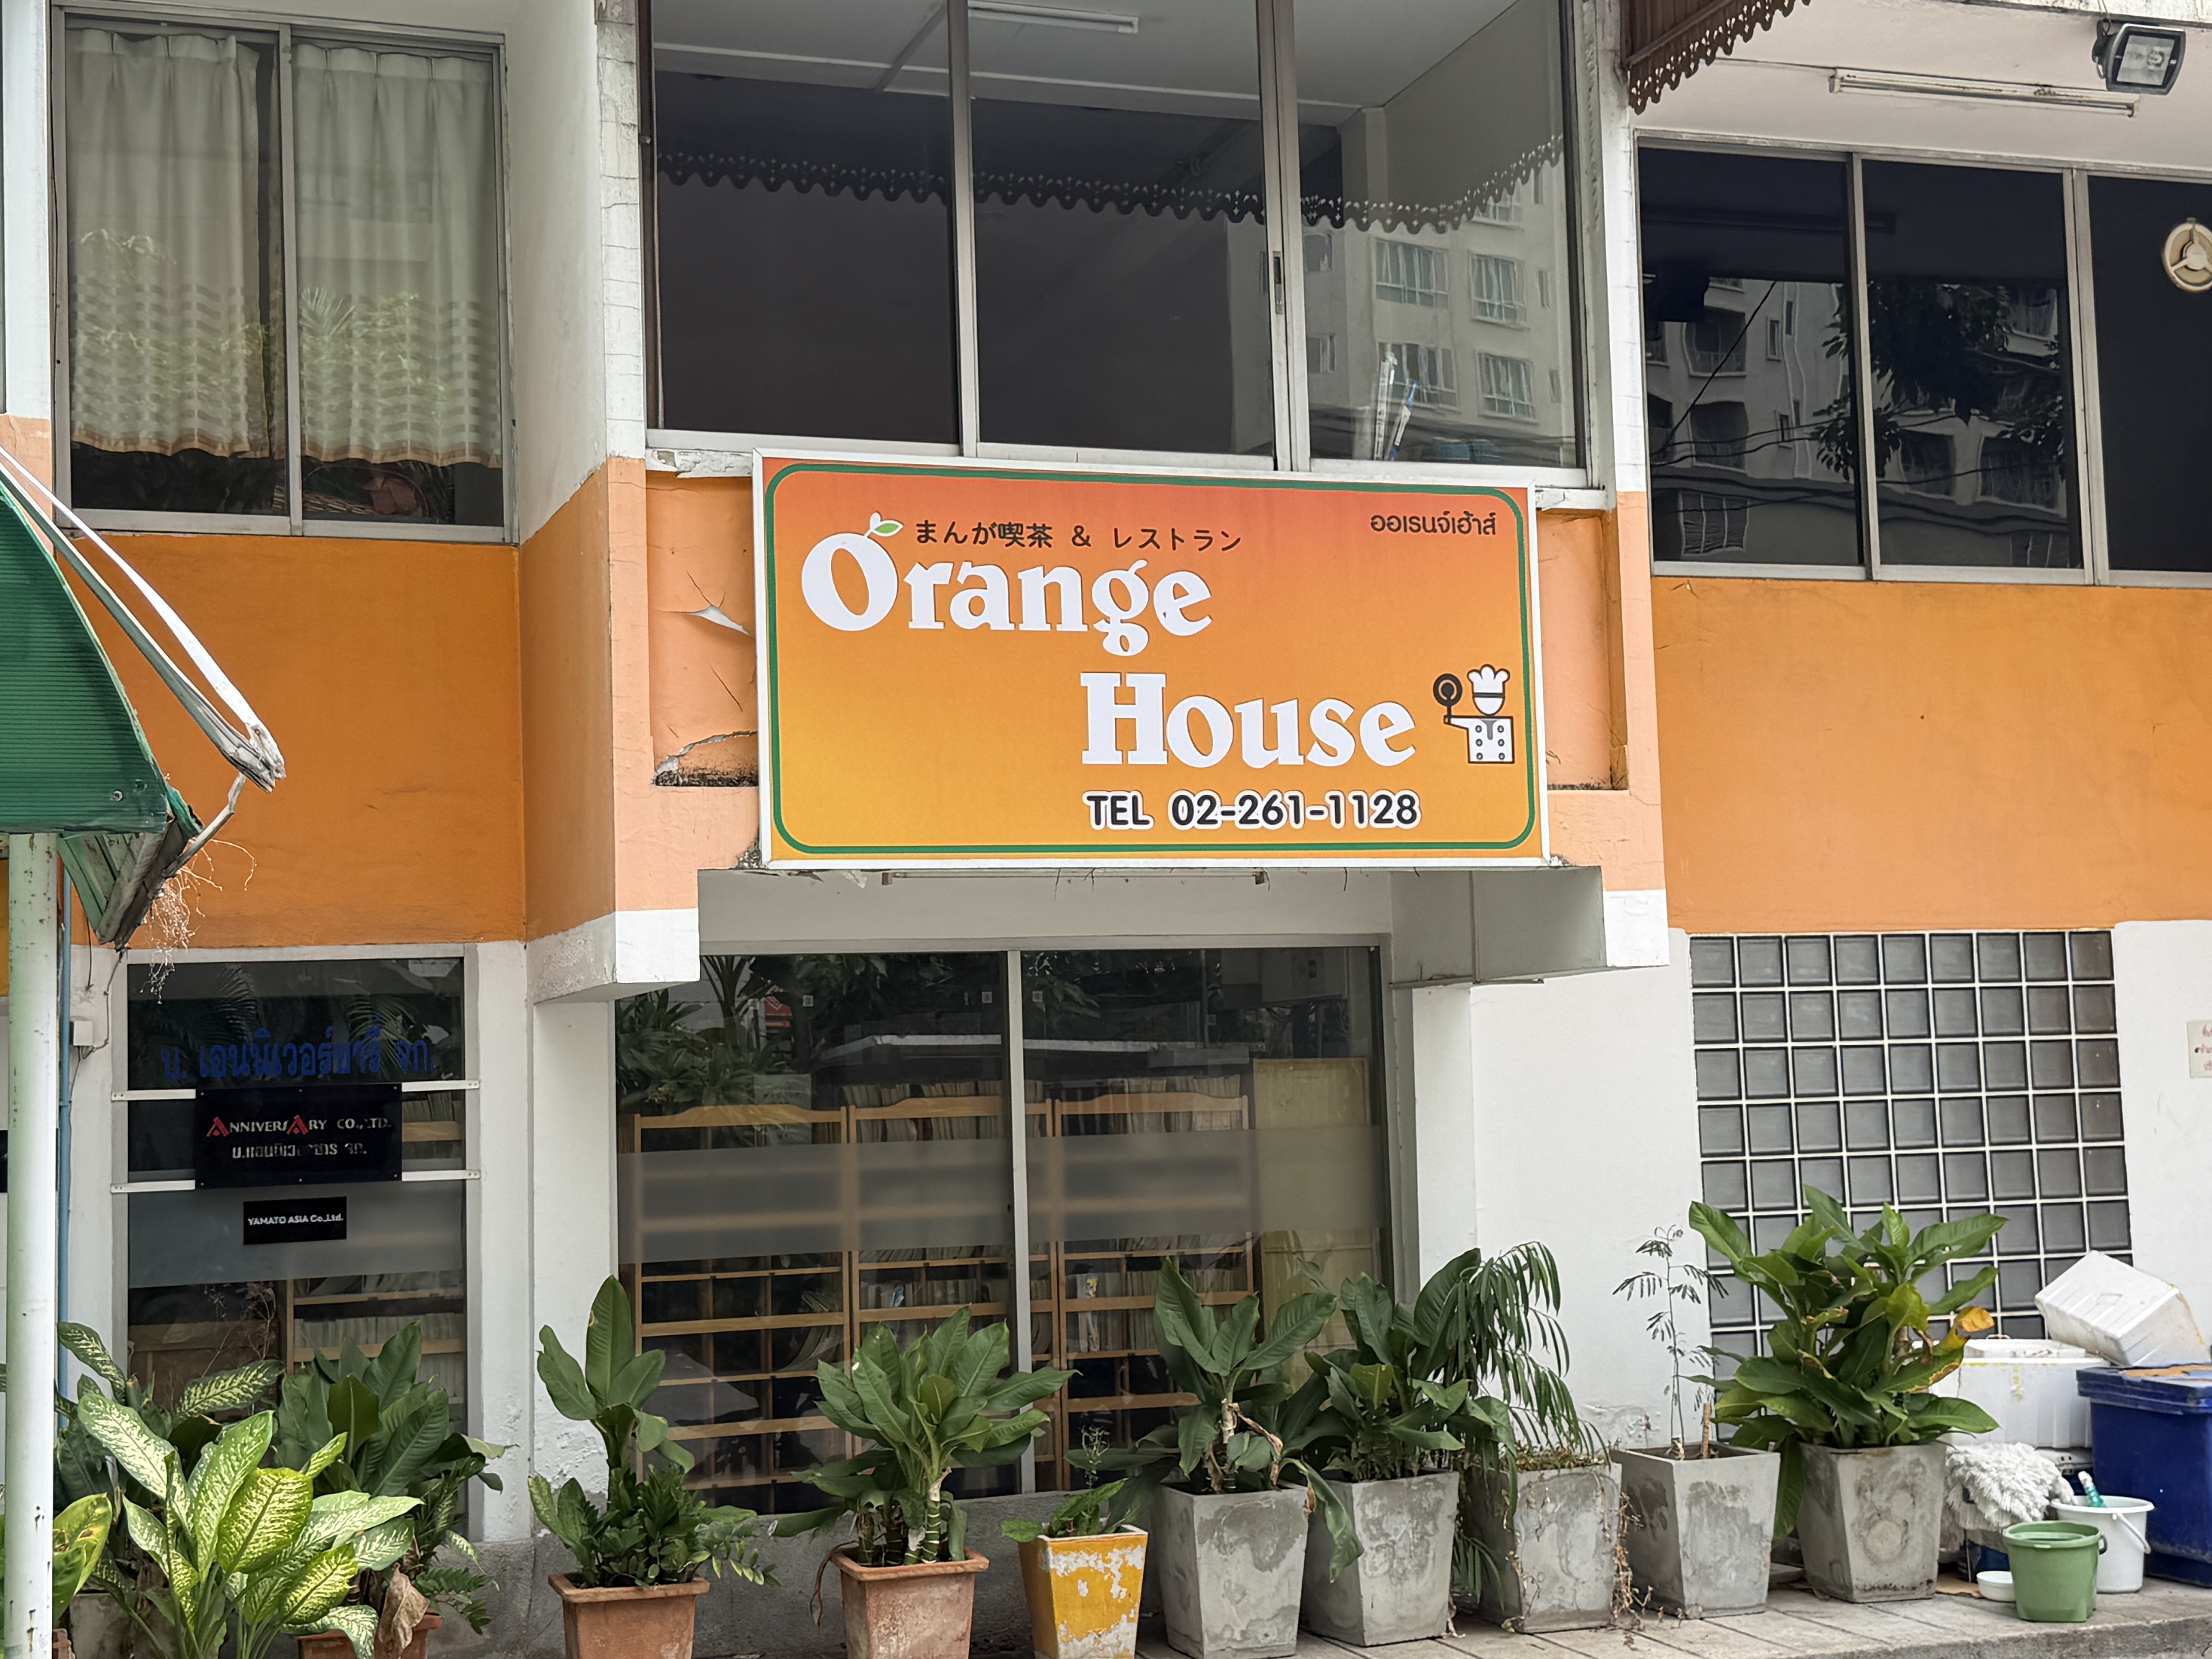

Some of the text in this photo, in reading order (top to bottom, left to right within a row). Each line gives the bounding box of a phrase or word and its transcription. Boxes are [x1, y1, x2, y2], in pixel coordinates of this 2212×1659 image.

[916, 519, 1242, 551] まんが喫茶 & レストラン
[1370, 510, 1496, 535] ออเรนจ์เฮ้าส์
[801, 532, 1212, 656] Orange
[1080, 672, 1416, 768] House
[1085, 792, 1419, 827] TEL 02-261-1128
[248, 1216, 287, 1225] YAMATO
[288, 1215, 309, 1223] ASIA
